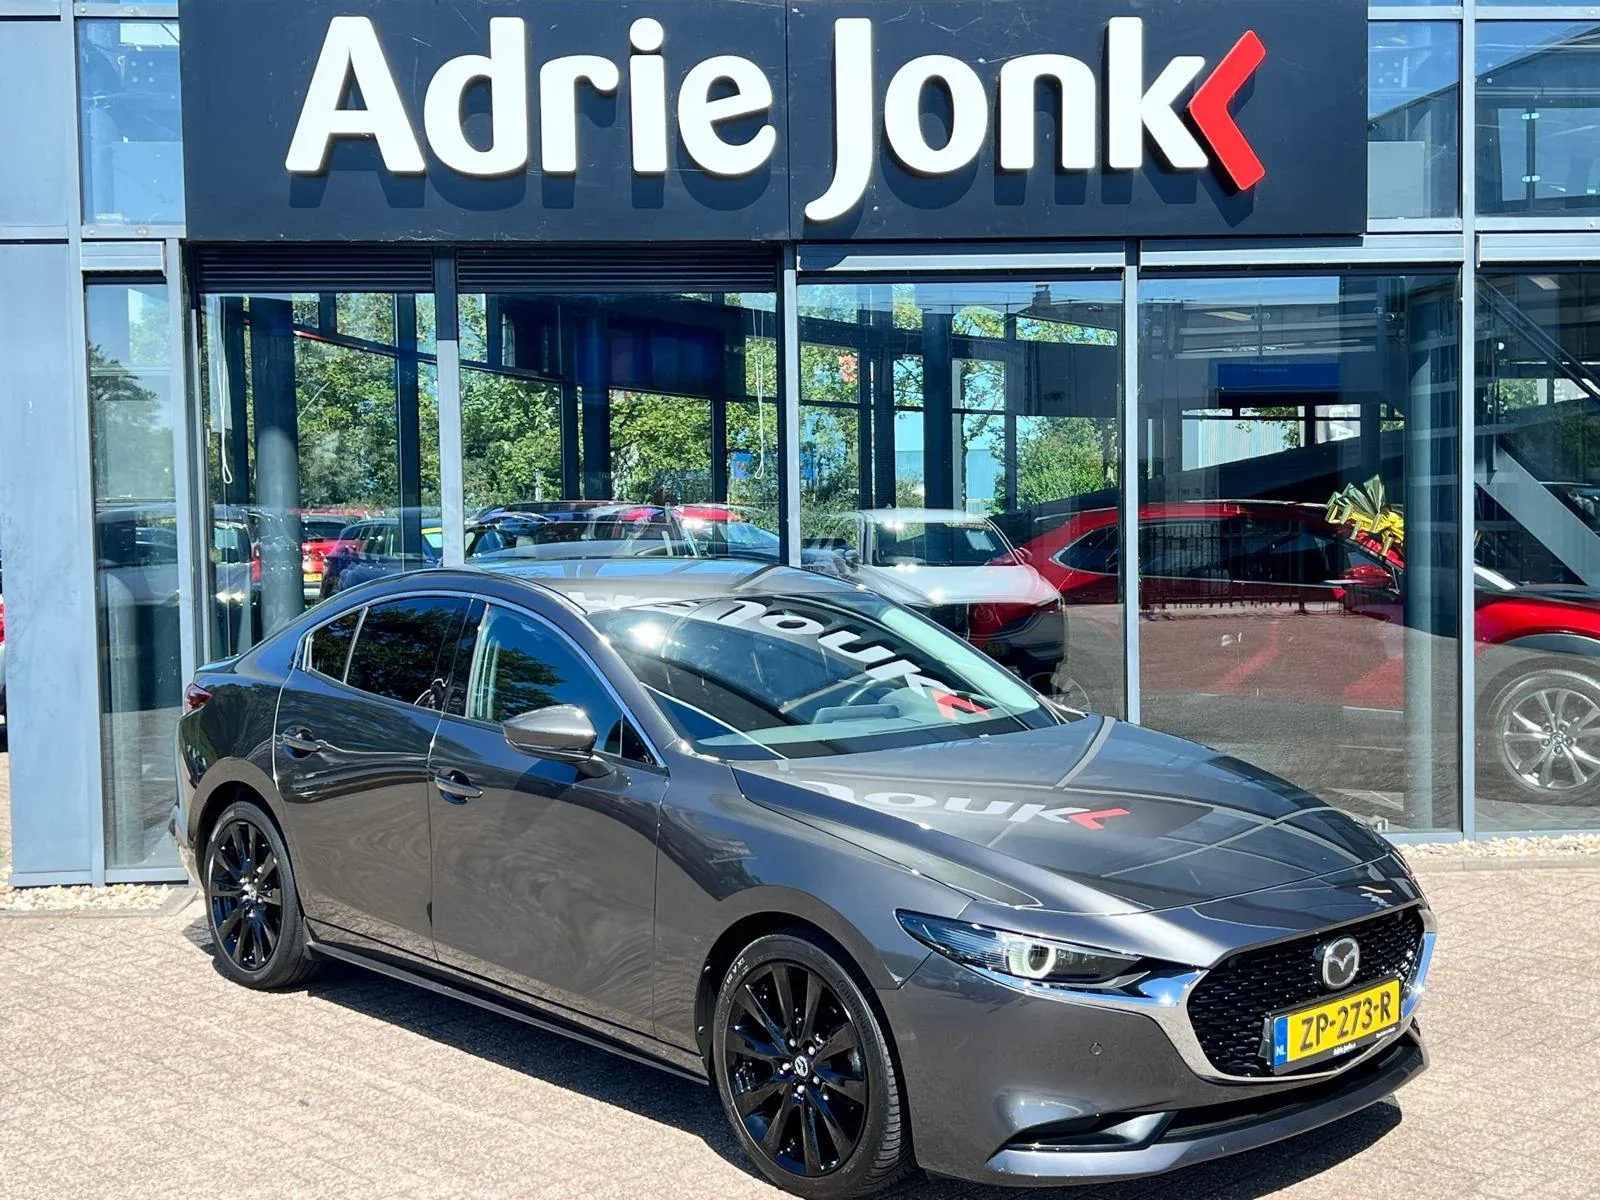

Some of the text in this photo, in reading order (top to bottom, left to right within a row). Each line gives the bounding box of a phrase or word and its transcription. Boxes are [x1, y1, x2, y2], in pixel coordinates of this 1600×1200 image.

[286, 16, 1207, 221] Adrie Jonk
[1275, 1045, 1286, 1057] NL
[1300, 990, 1391, 1051] ZP-273-R
